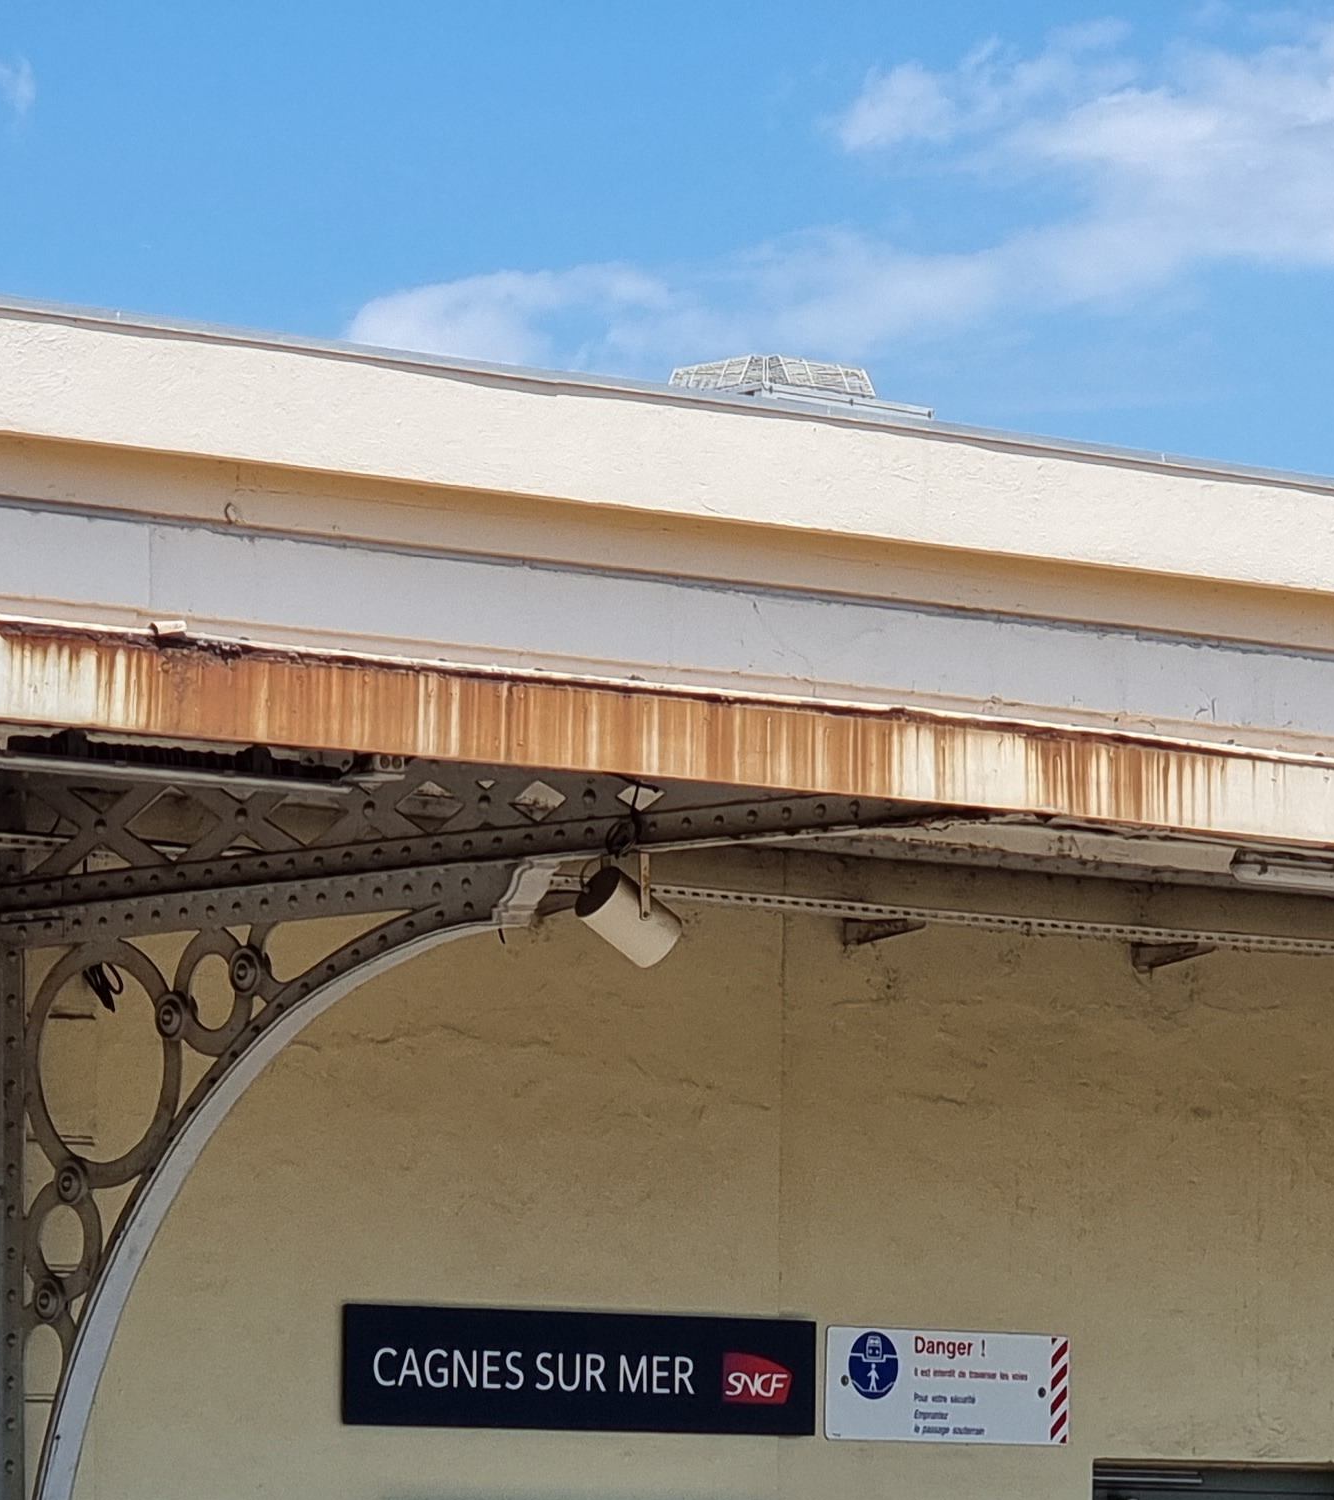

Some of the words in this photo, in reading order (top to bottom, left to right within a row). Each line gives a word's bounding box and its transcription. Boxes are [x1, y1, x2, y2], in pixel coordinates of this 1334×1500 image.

[913, 1335, 974, 1360] Danger
[980, 1338, 987, 1358] !
[372, 1346, 525, 1390] CAGNES
[534, 1351, 607, 1393] SUR
[618, 1354, 696, 1395] MER
[724, 1371, 789, 1398] SNCF
[913, 1391, 929, 1404] Pour
[921, 1425, 951, 1437] passage
